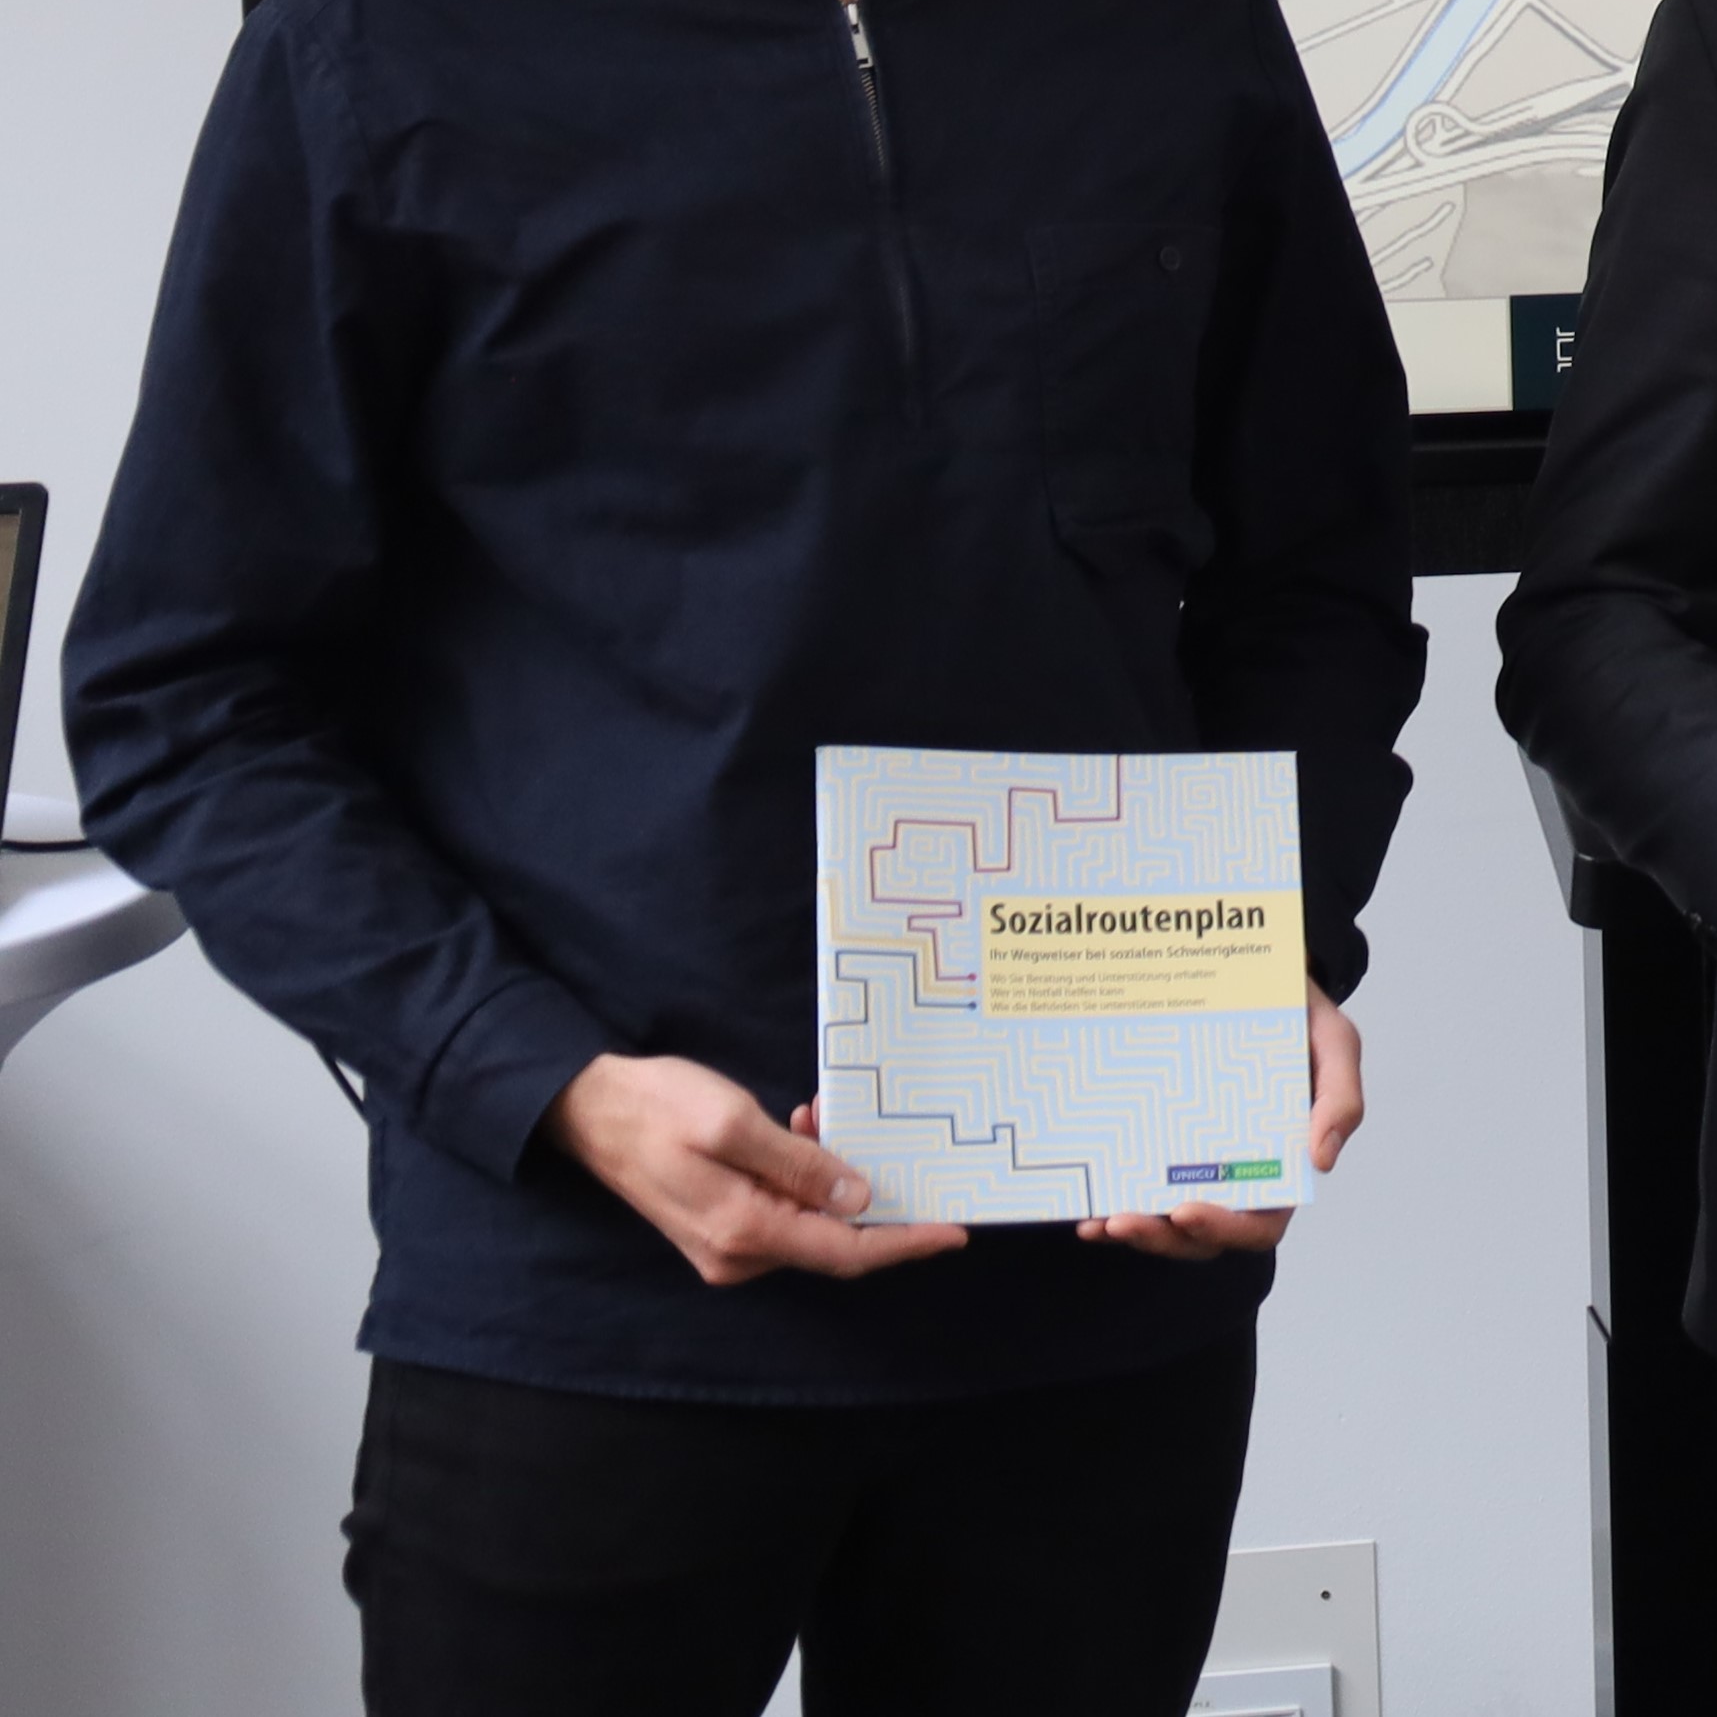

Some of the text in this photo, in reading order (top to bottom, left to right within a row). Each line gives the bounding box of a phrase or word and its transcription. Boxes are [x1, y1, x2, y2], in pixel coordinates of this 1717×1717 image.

[990, 899, 1265, 939] Sozialroutenplan
[990, 943, 1272, 964] Ihr Wegweiser bei sozialen Schwierigkeiten
